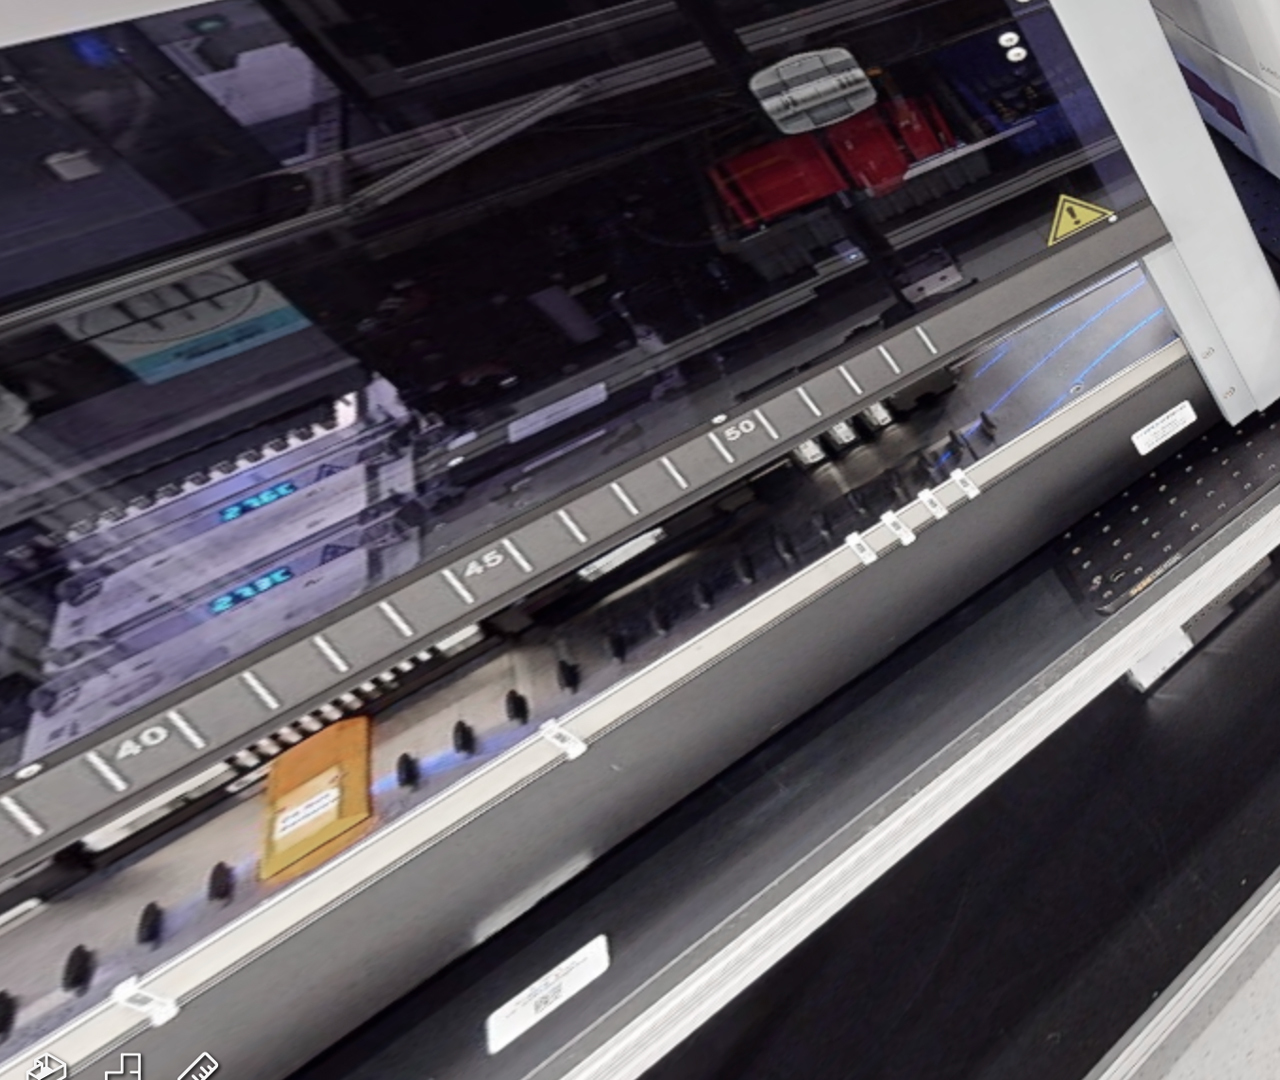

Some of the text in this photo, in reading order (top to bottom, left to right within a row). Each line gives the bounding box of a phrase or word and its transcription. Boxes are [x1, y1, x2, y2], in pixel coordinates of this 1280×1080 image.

[725, 420, 756, 441] 50
[464, 550, 504, 577] 45
[116, 726, 169, 760] 40
